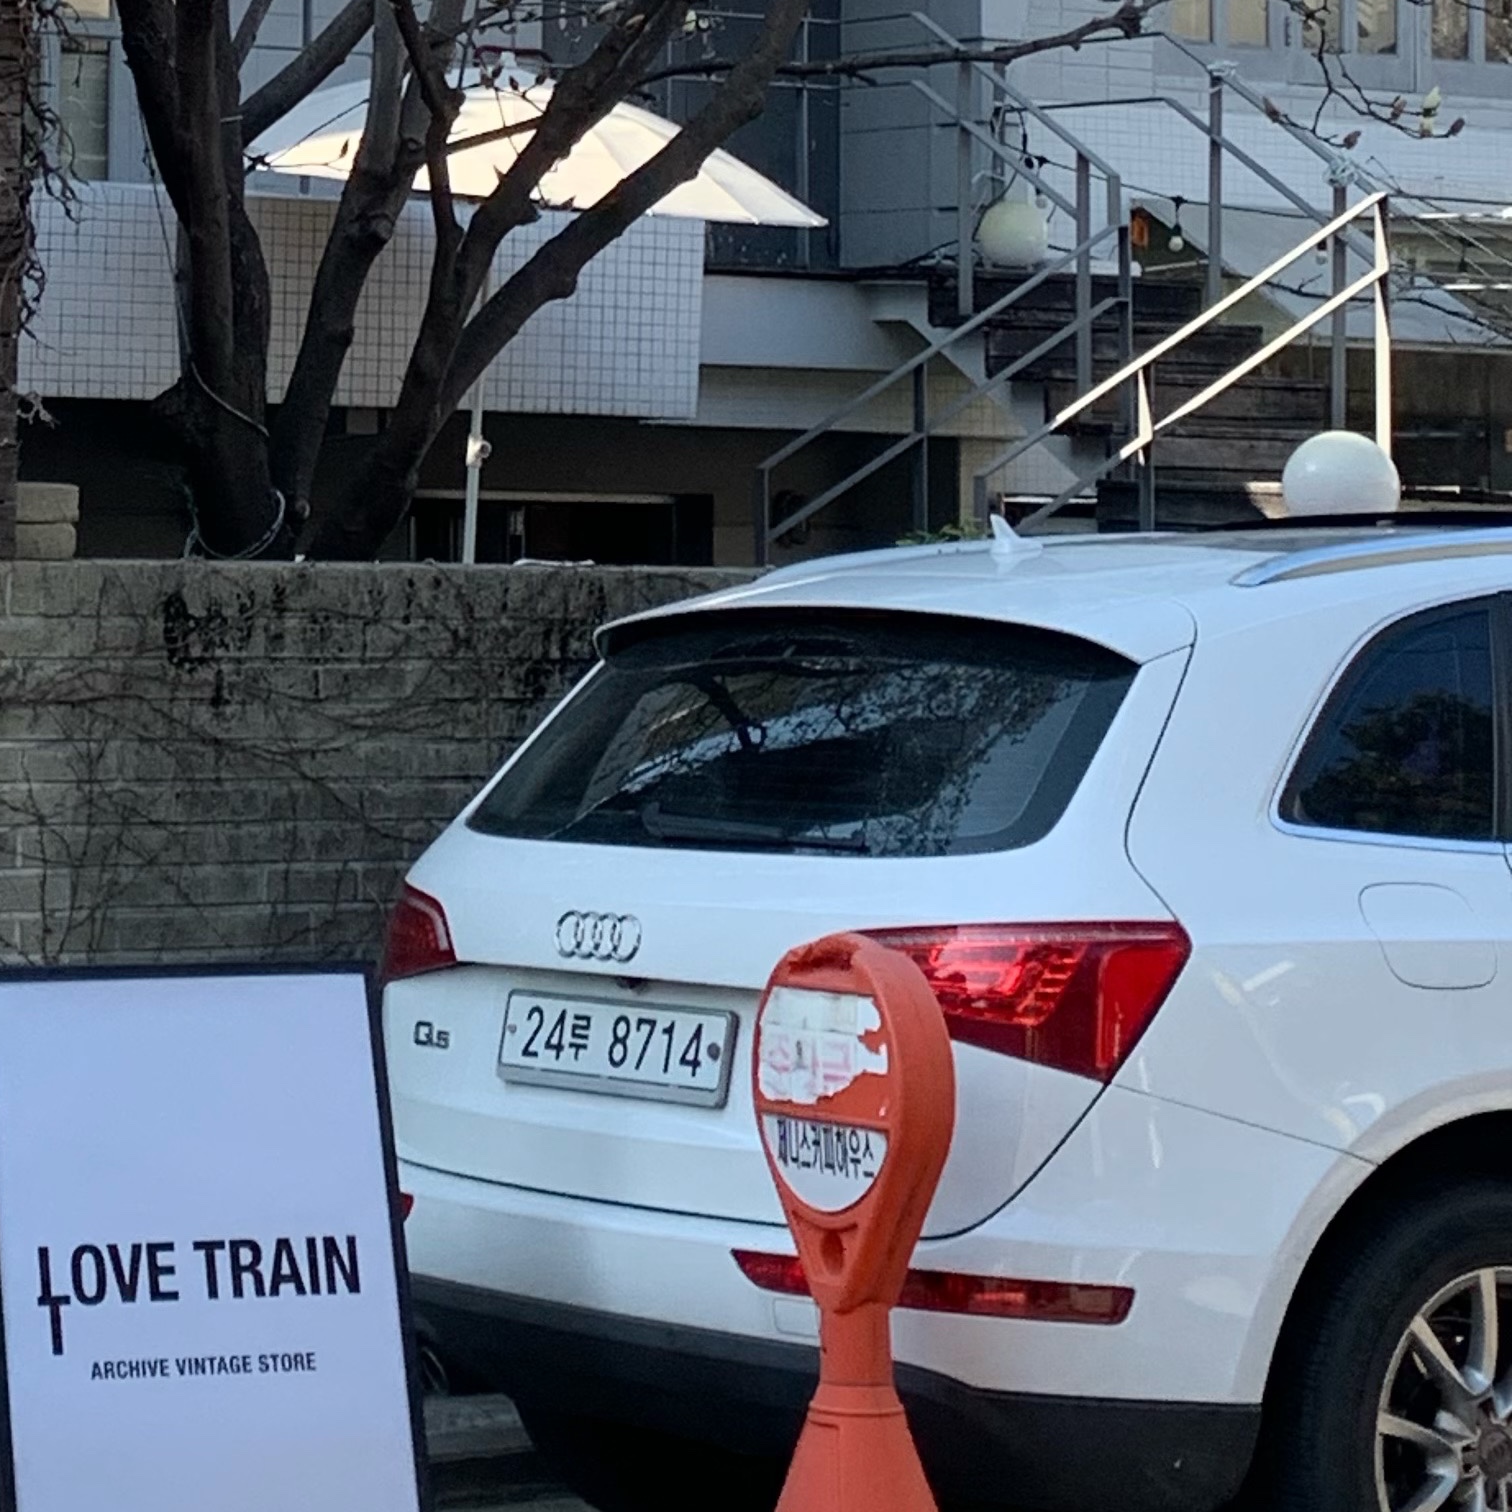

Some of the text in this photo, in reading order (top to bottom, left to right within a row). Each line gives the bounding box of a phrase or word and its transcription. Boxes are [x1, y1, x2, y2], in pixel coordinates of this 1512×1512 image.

[412, 1020, 450, 1050] Q5
[521, 1005, 593, 1062] 24루
[607, 1014, 705, 1078] 8714
[37, 1234, 362, 1356] LOVE TRAIN
[91, 1351, 317, 1381] ARCHIVE VINTAGE STORE
